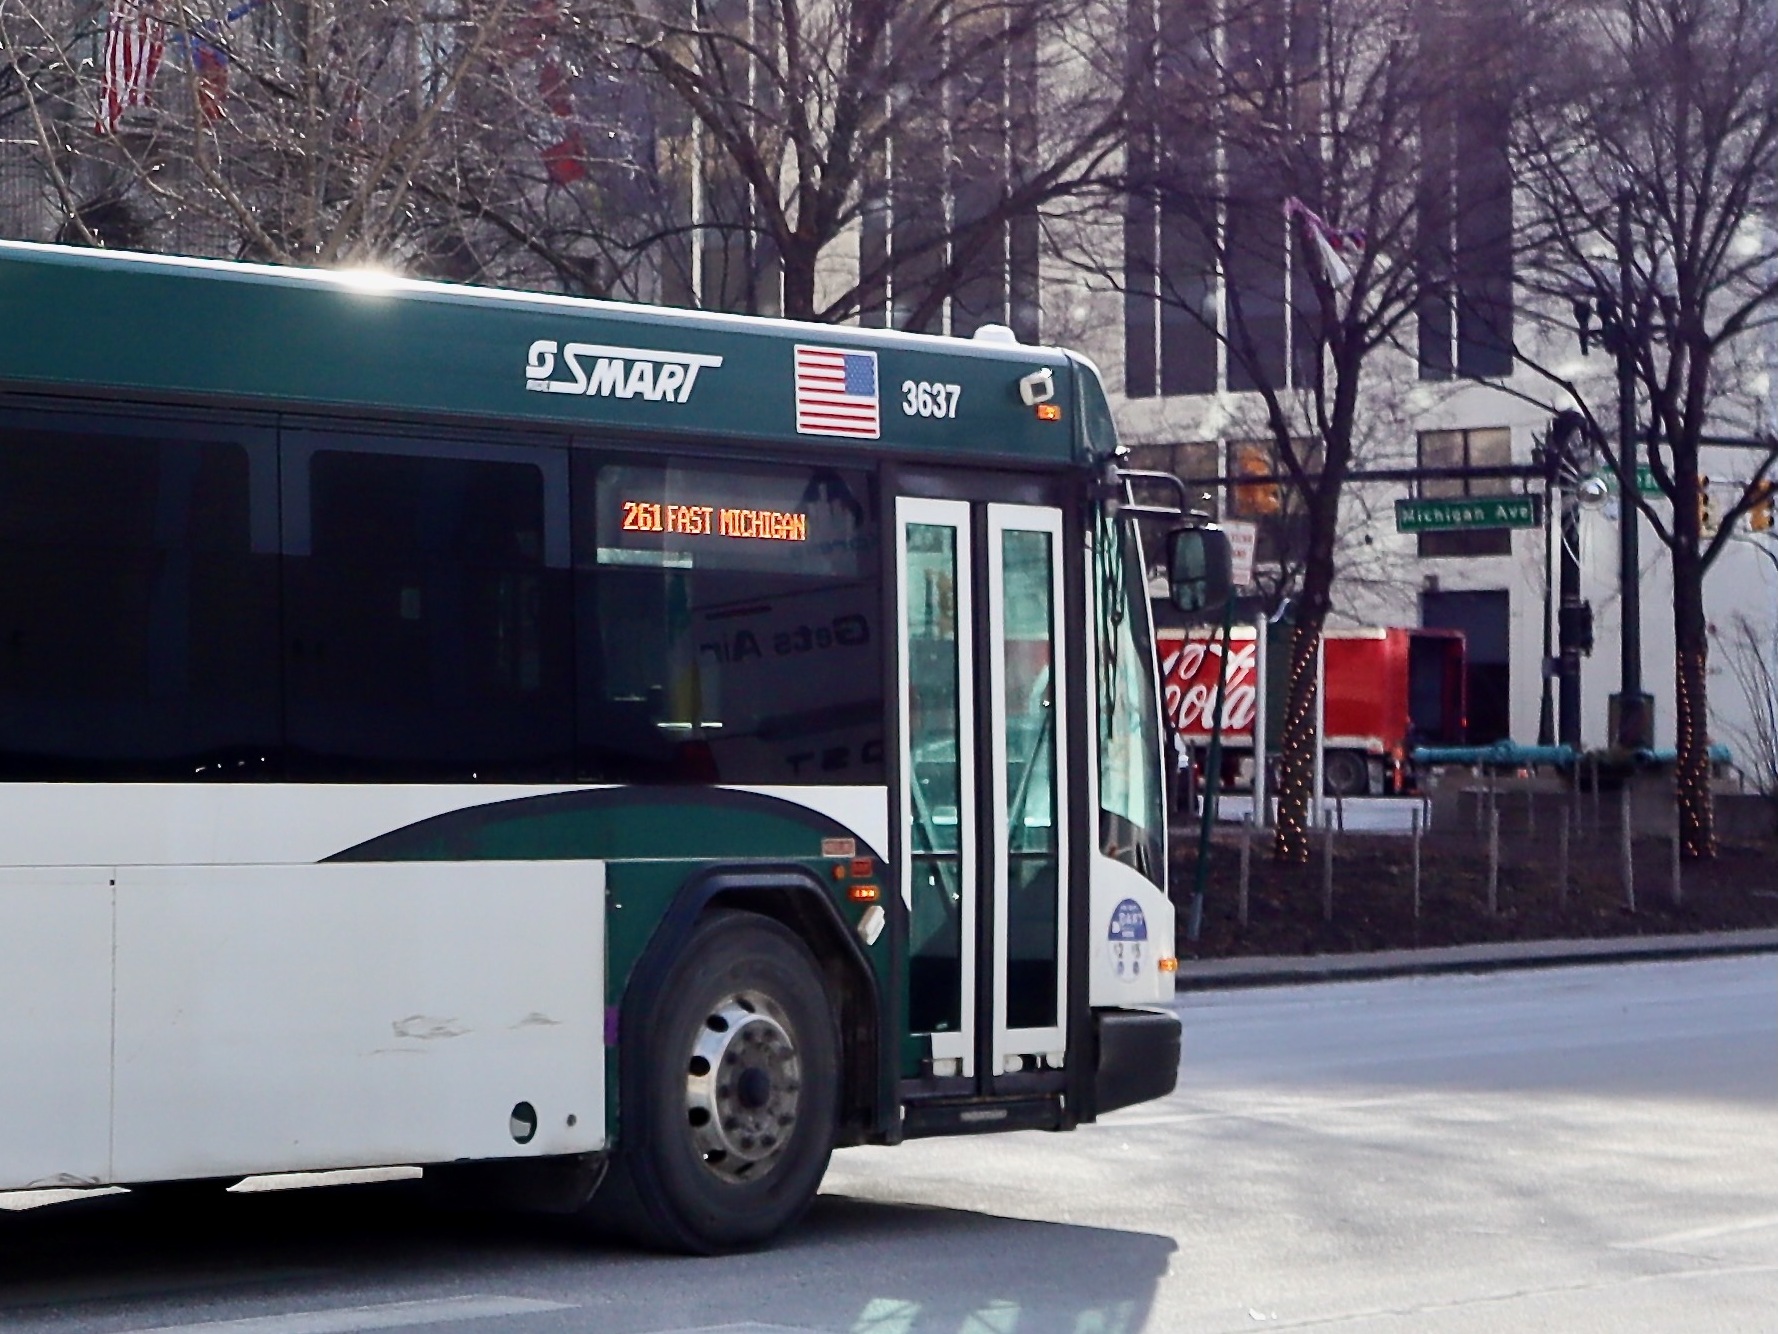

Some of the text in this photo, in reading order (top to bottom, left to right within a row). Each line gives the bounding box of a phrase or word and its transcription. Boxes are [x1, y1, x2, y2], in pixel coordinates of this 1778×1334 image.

[546, 342, 723, 404] SMART
[901, 380, 961, 419] 3637
[622, 501, 807, 542] 261 FAST MICHIGAN
[1402, 505, 1529, 524] Michigan Ave
